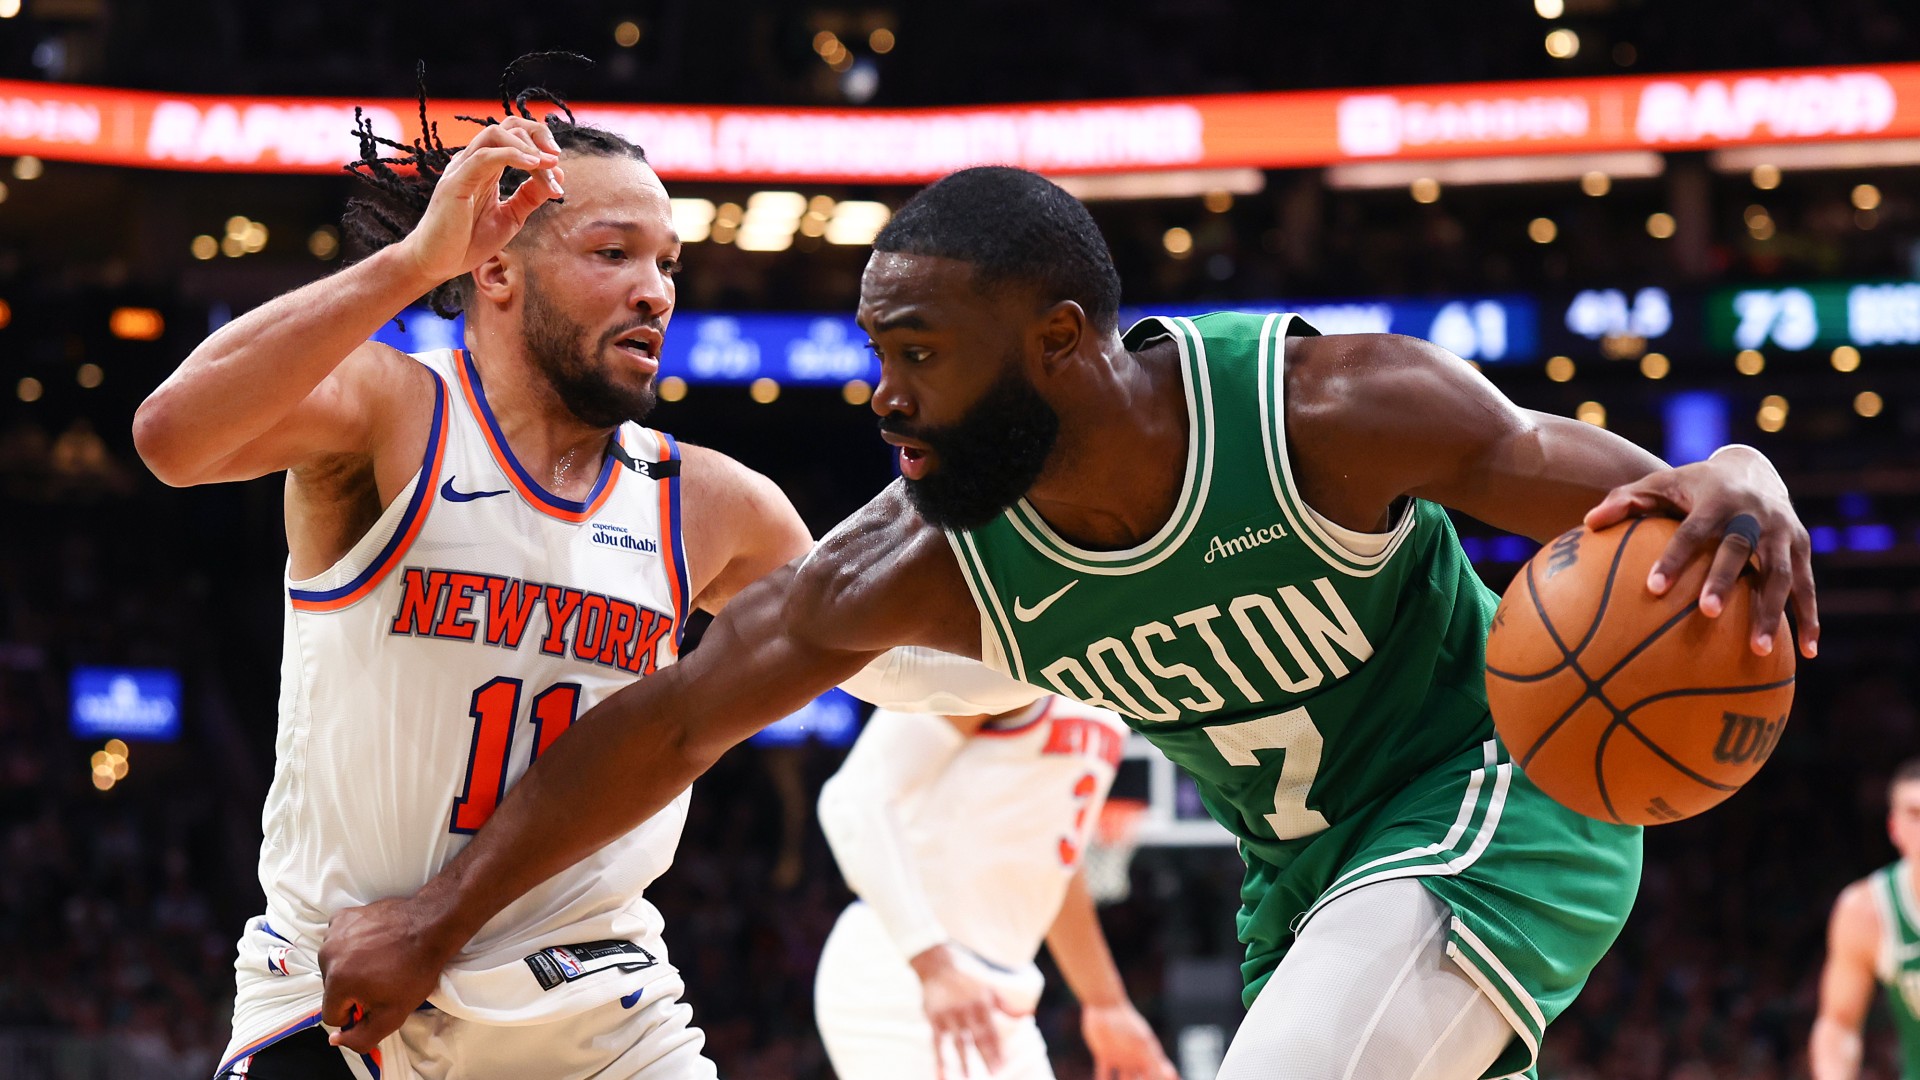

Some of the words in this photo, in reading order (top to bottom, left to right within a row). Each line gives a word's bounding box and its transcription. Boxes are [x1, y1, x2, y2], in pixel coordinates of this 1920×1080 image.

[633, 459, 650, 476] 12
[592, 522, 628, 534] experience
[592, 531, 618, 546] abu
[620, 534, 657, 553] dhabi
[1203, 522, 1288, 564] Amica
[389, 566, 541, 650] NEW
[539, 582, 674, 677] YORK
[1040, 576, 1375, 722] BOSTON
[1202, 705, 1331, 841] 7
